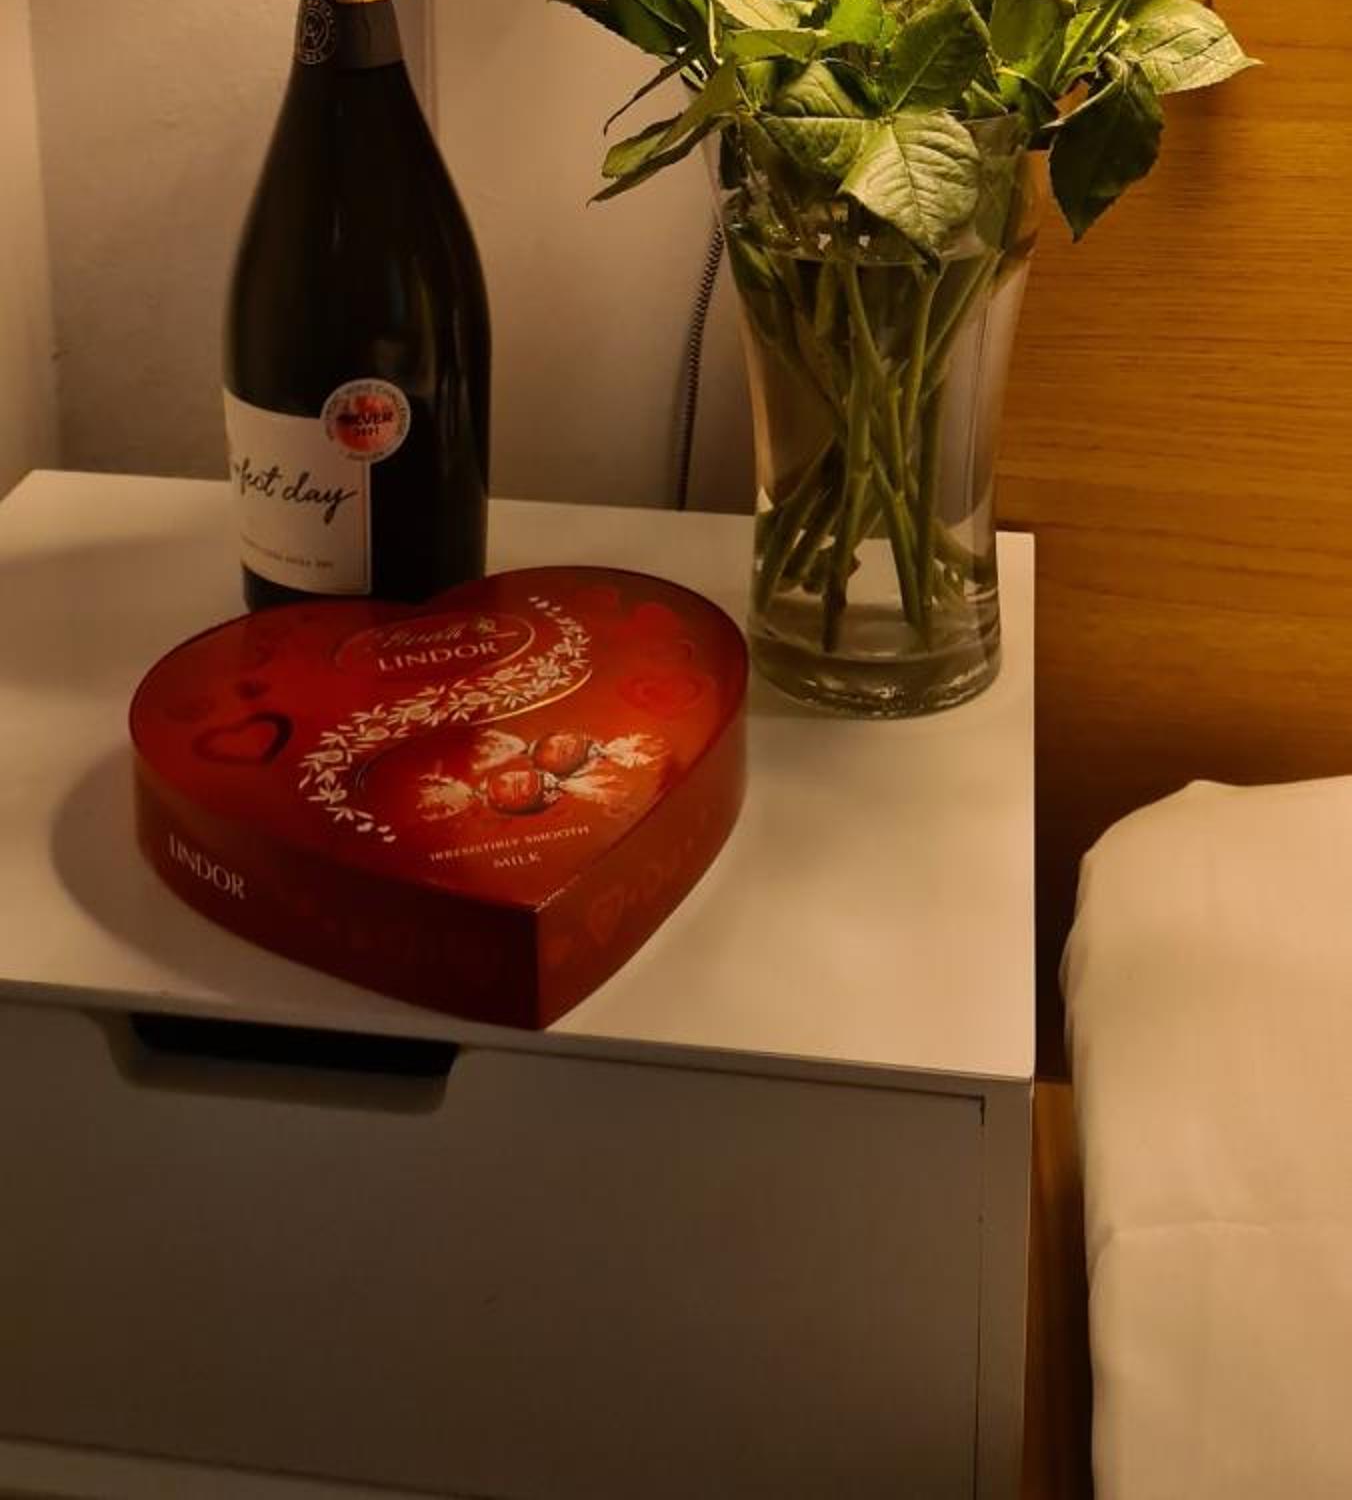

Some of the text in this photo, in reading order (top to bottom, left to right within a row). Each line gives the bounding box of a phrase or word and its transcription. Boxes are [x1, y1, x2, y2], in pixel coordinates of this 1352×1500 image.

[282, 471, 358, 524] day
[377, 641, 498, 671] LINDOR
[524, 825, 590, 844] SMOOTH
[168, 832, 245, 899] LINDOR
[493, 851, 542, 869] MILK
